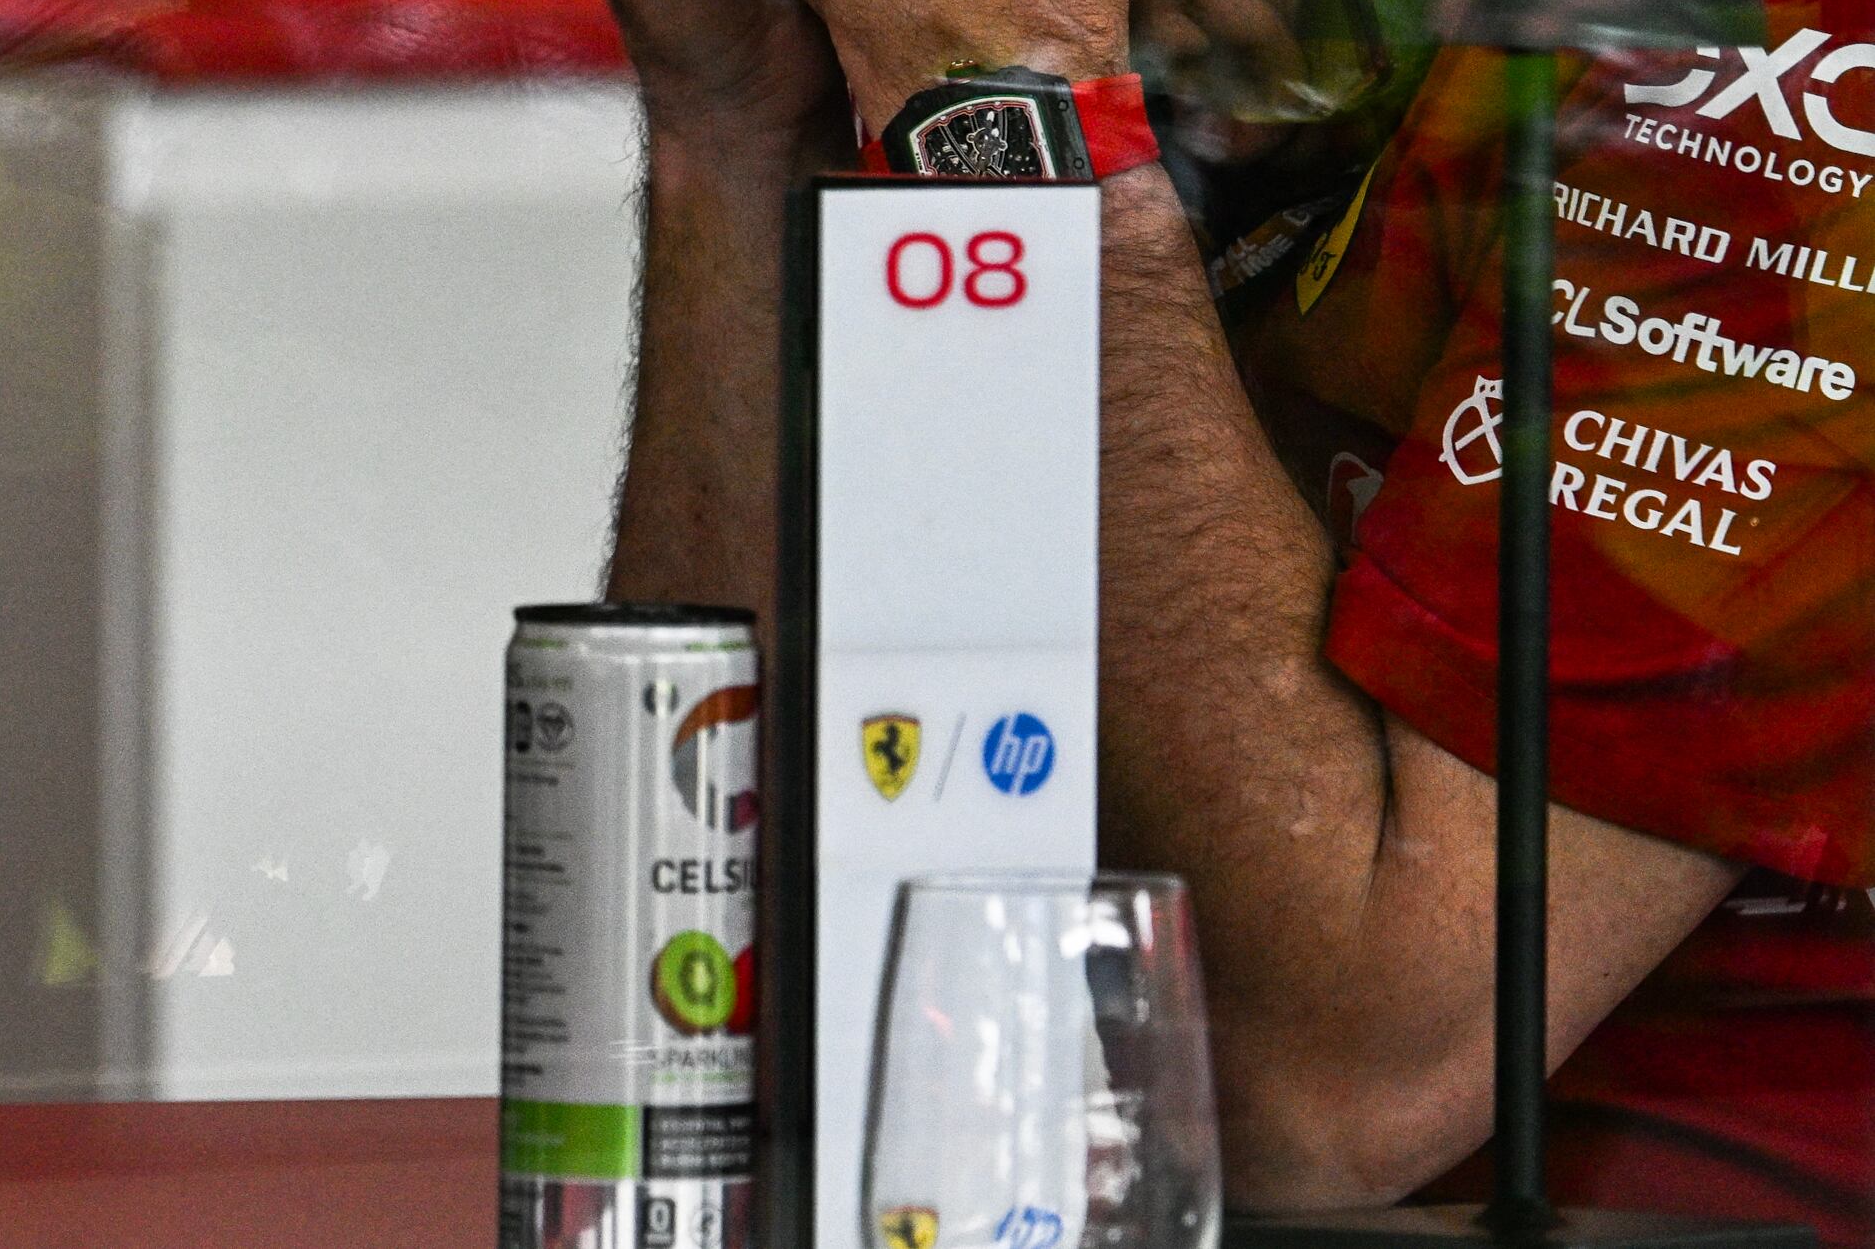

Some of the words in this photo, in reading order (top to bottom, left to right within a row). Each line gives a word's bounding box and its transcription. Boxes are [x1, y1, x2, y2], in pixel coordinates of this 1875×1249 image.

[1624, 113, 1873, 199] TECHNOLOGY
[885, 231, 1028, 310] 08
[1745, 237, 1875, 296] MILL
[1563, 409, 1777, 501] CHIVAS
[1549, 460, 1743, 557] REGAL
[988, 713, 1051, 797] hp
